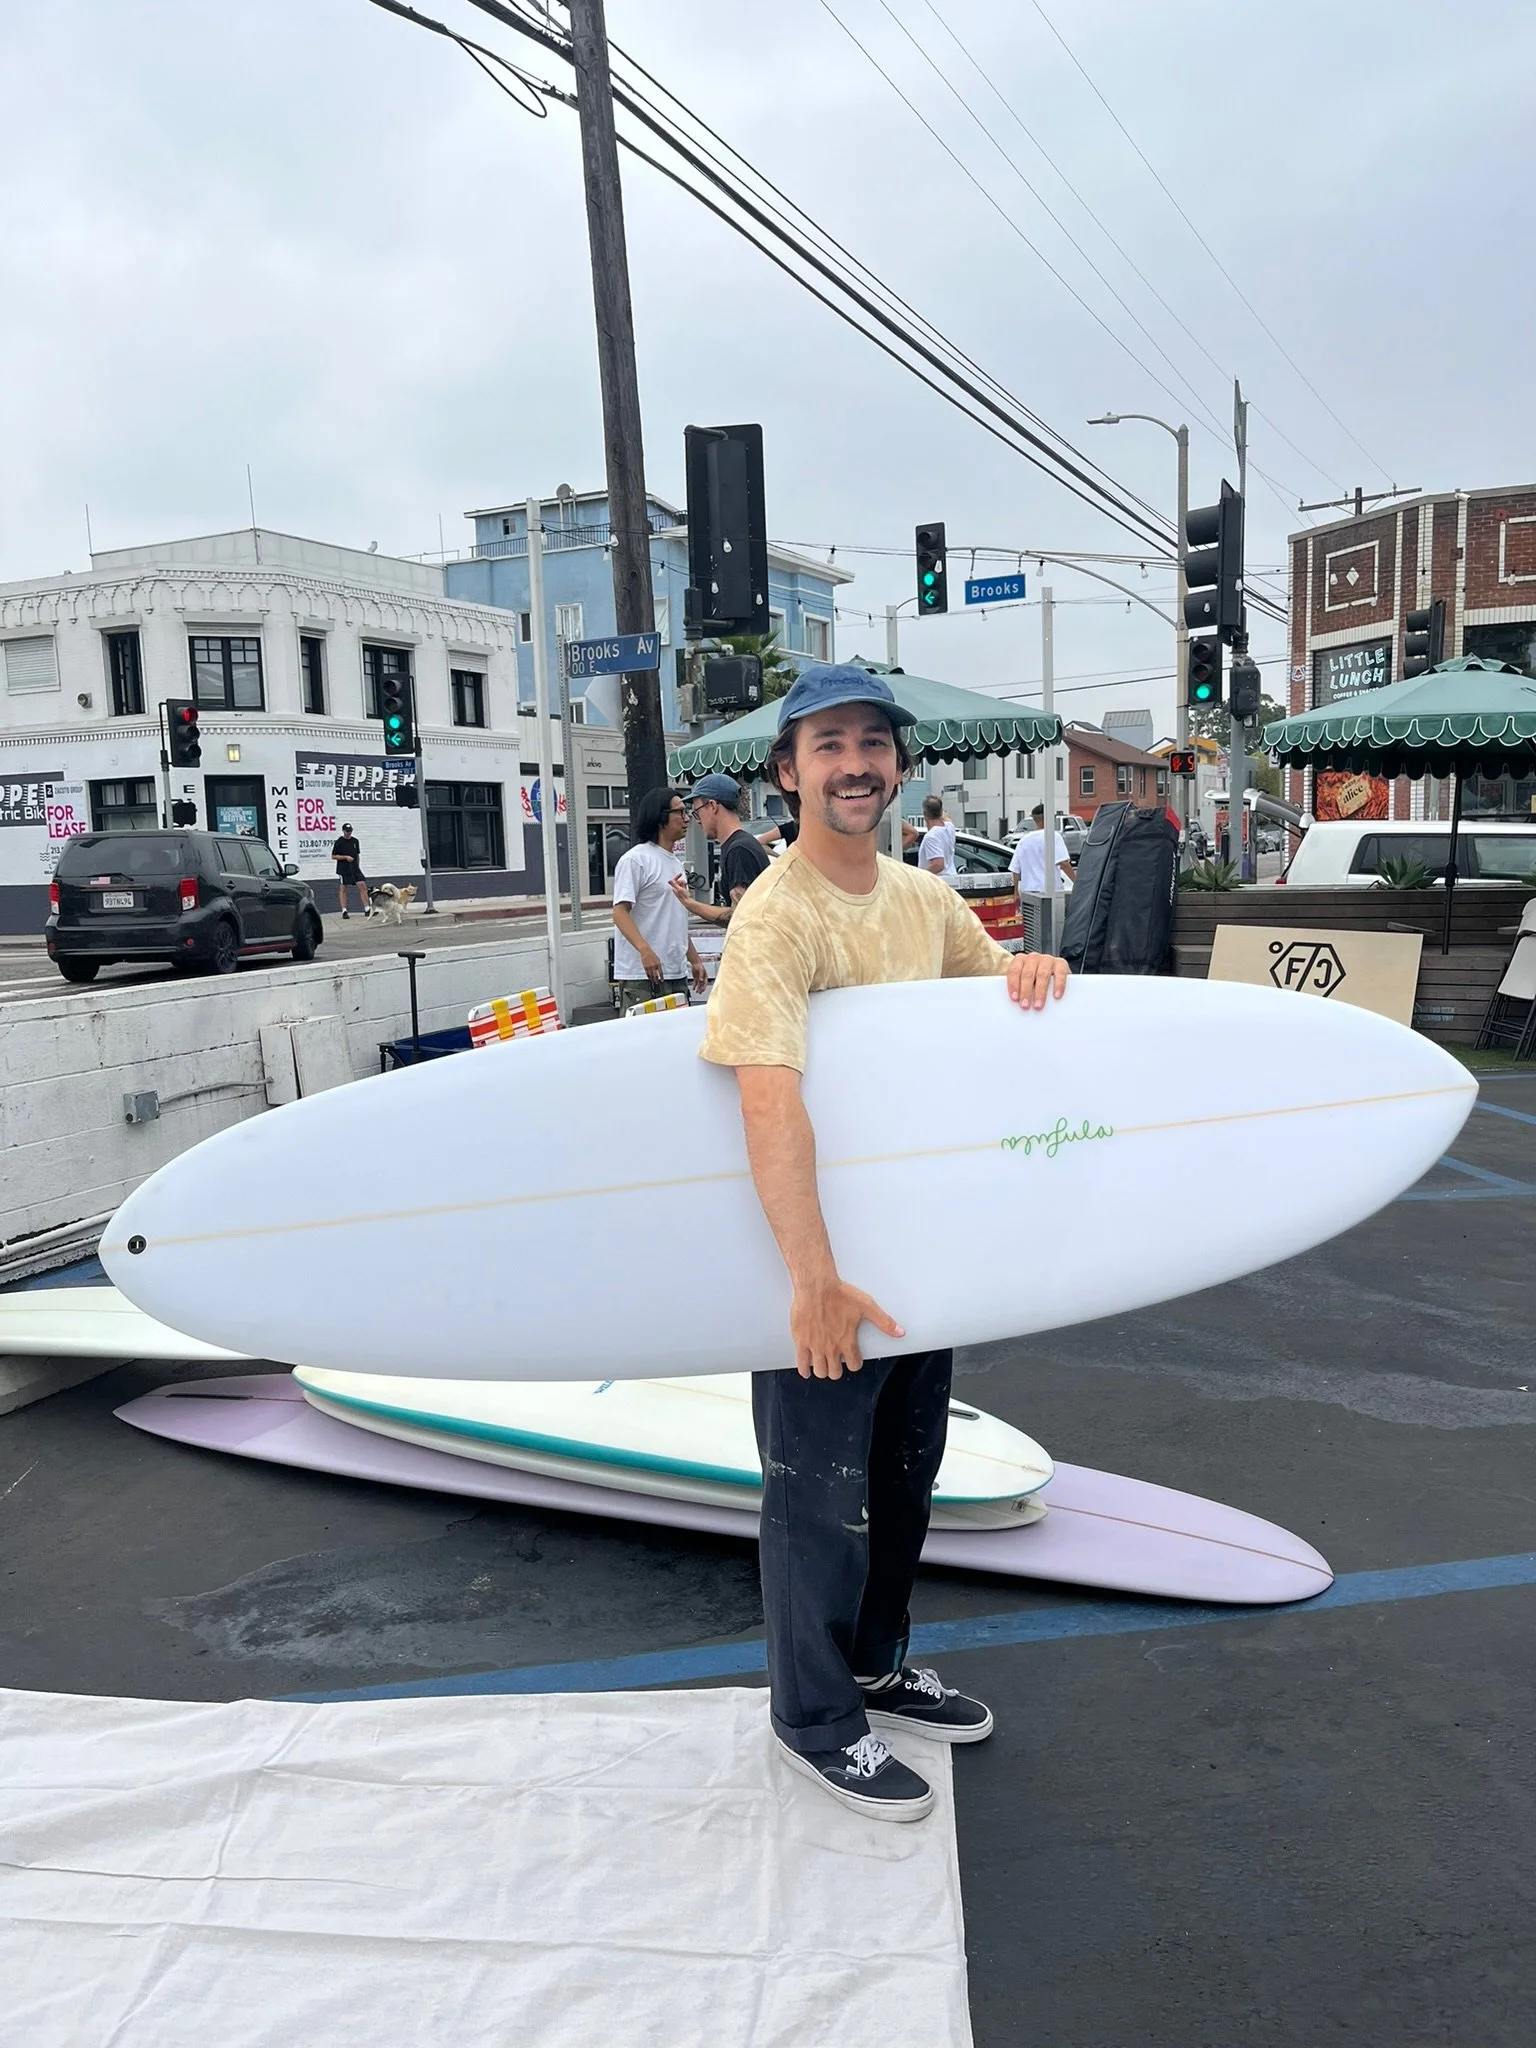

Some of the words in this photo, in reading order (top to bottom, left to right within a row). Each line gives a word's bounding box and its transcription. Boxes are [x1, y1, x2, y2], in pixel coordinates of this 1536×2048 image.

[970, 582, 1019, 598] Brooks
[571, 642, 620, 662] Brooks
[637, 637, 654, 655] Av
[1329, 648, 1385, 672] LITTLE
[1330, 667, 1384, 690] LUNCH
[24, 806, 45, 820] Bik
[47, 805, 74, 821] FOR
[297, 798, 324, 814] FOR
[297, 816, 337, 831] LEASE
[672, 843, 686, 852] EASE
